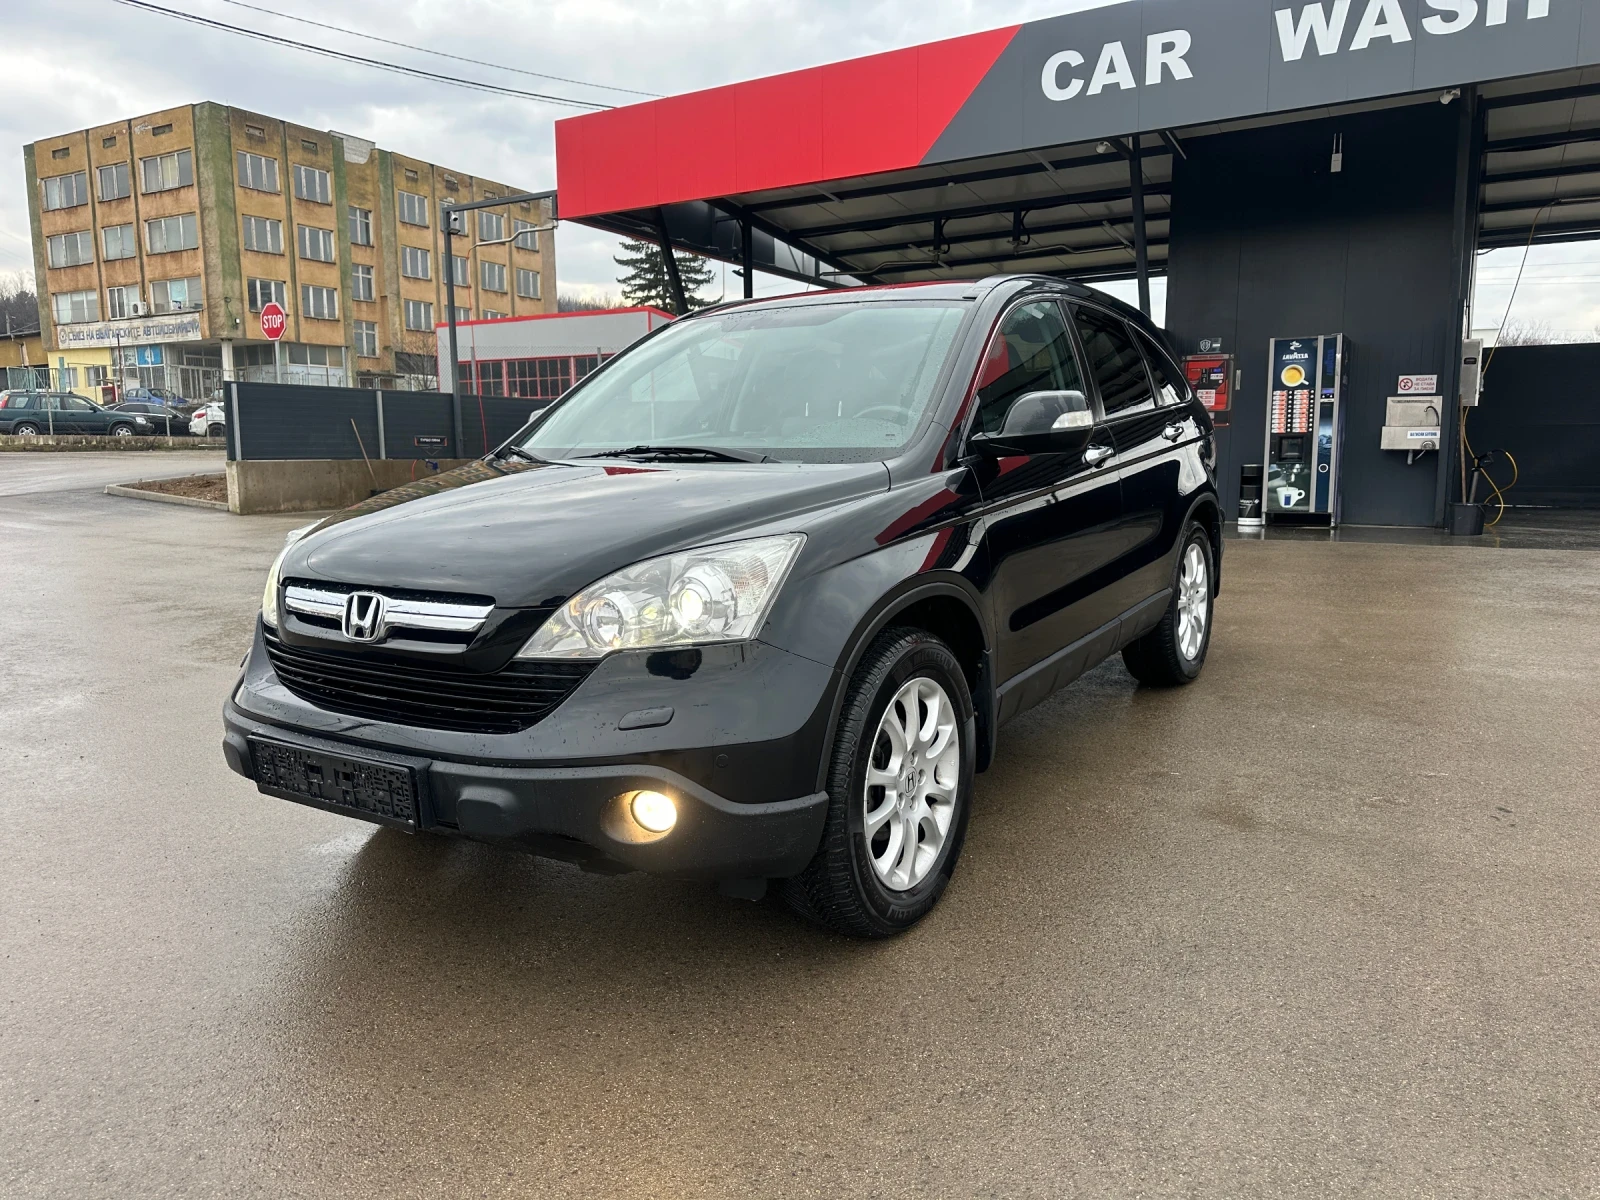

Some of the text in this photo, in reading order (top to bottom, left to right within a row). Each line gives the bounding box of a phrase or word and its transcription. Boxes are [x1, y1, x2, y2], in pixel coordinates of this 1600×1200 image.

[1041, 29, 1194, 101] CAR
[263, 315, 283, 329] STOP
[1282, 352, 1309, 360] LAVAZZA
